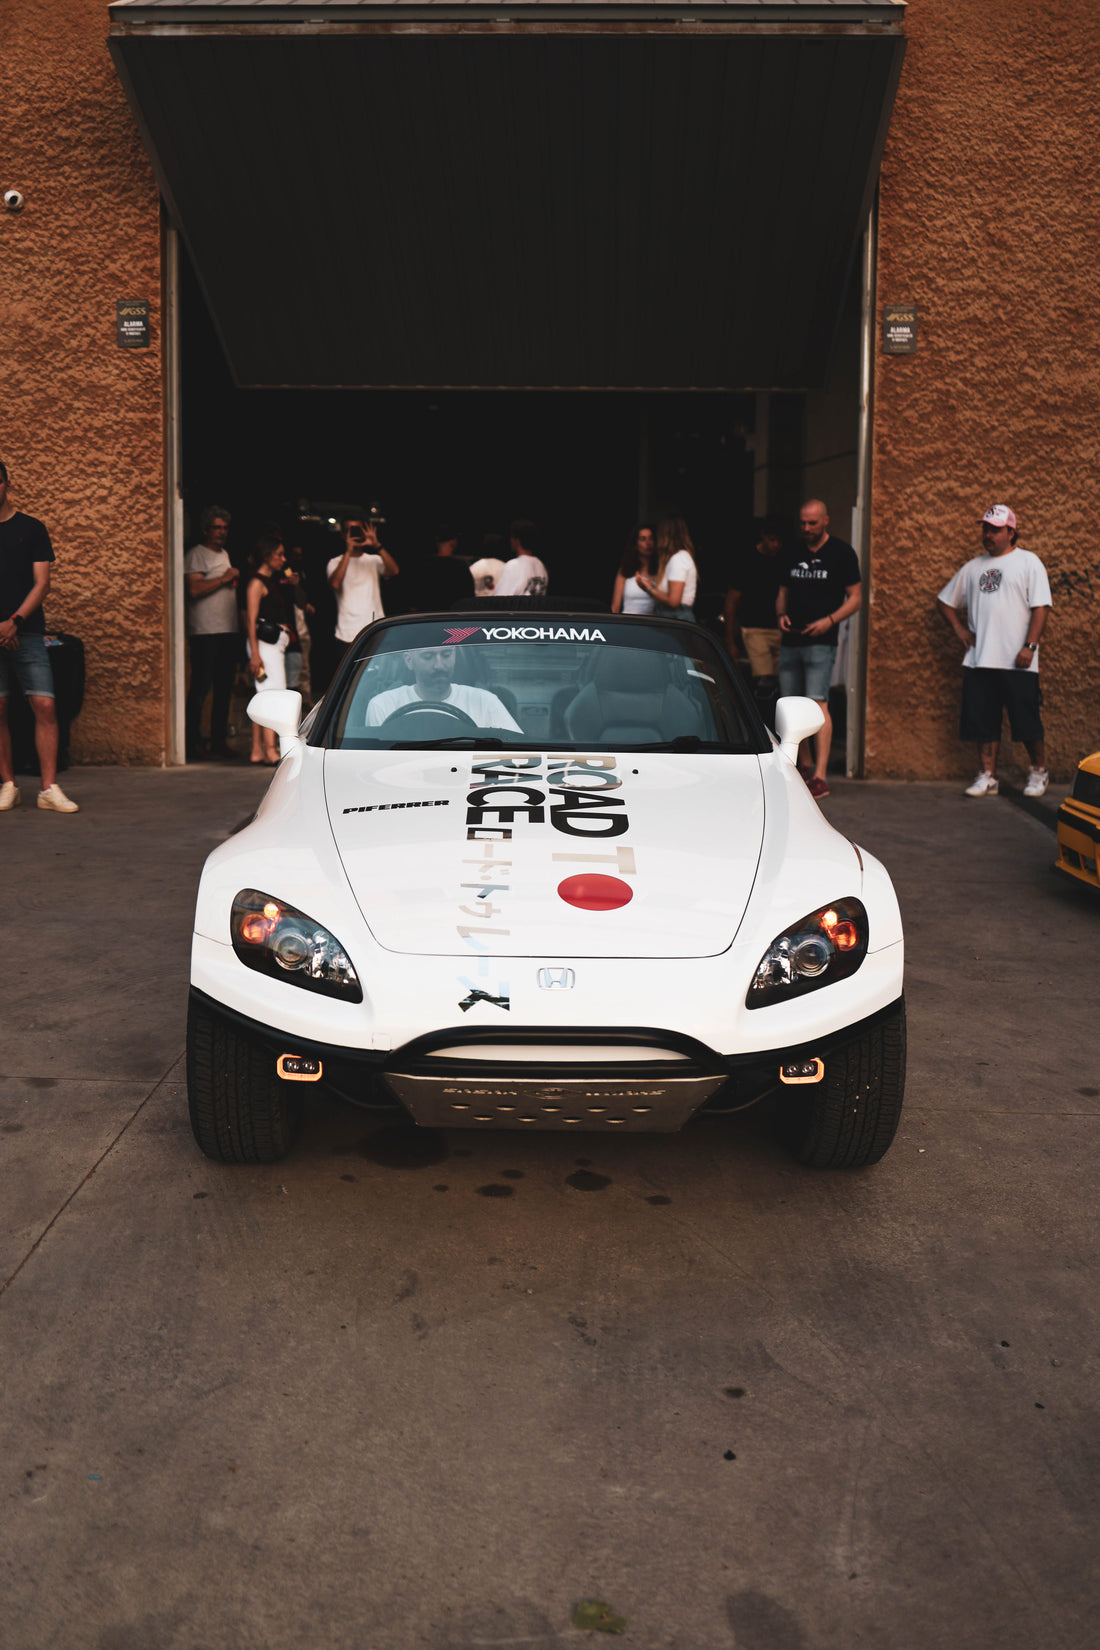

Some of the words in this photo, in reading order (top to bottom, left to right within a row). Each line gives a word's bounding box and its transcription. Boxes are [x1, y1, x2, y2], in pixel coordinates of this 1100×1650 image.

[482, 627, 607, 642] YOKOHAMA
[342, 800, 449, 815] PIFERRER
[466, 754, 546, 825] RACE
[547, 756, 630, 838] ROAD
